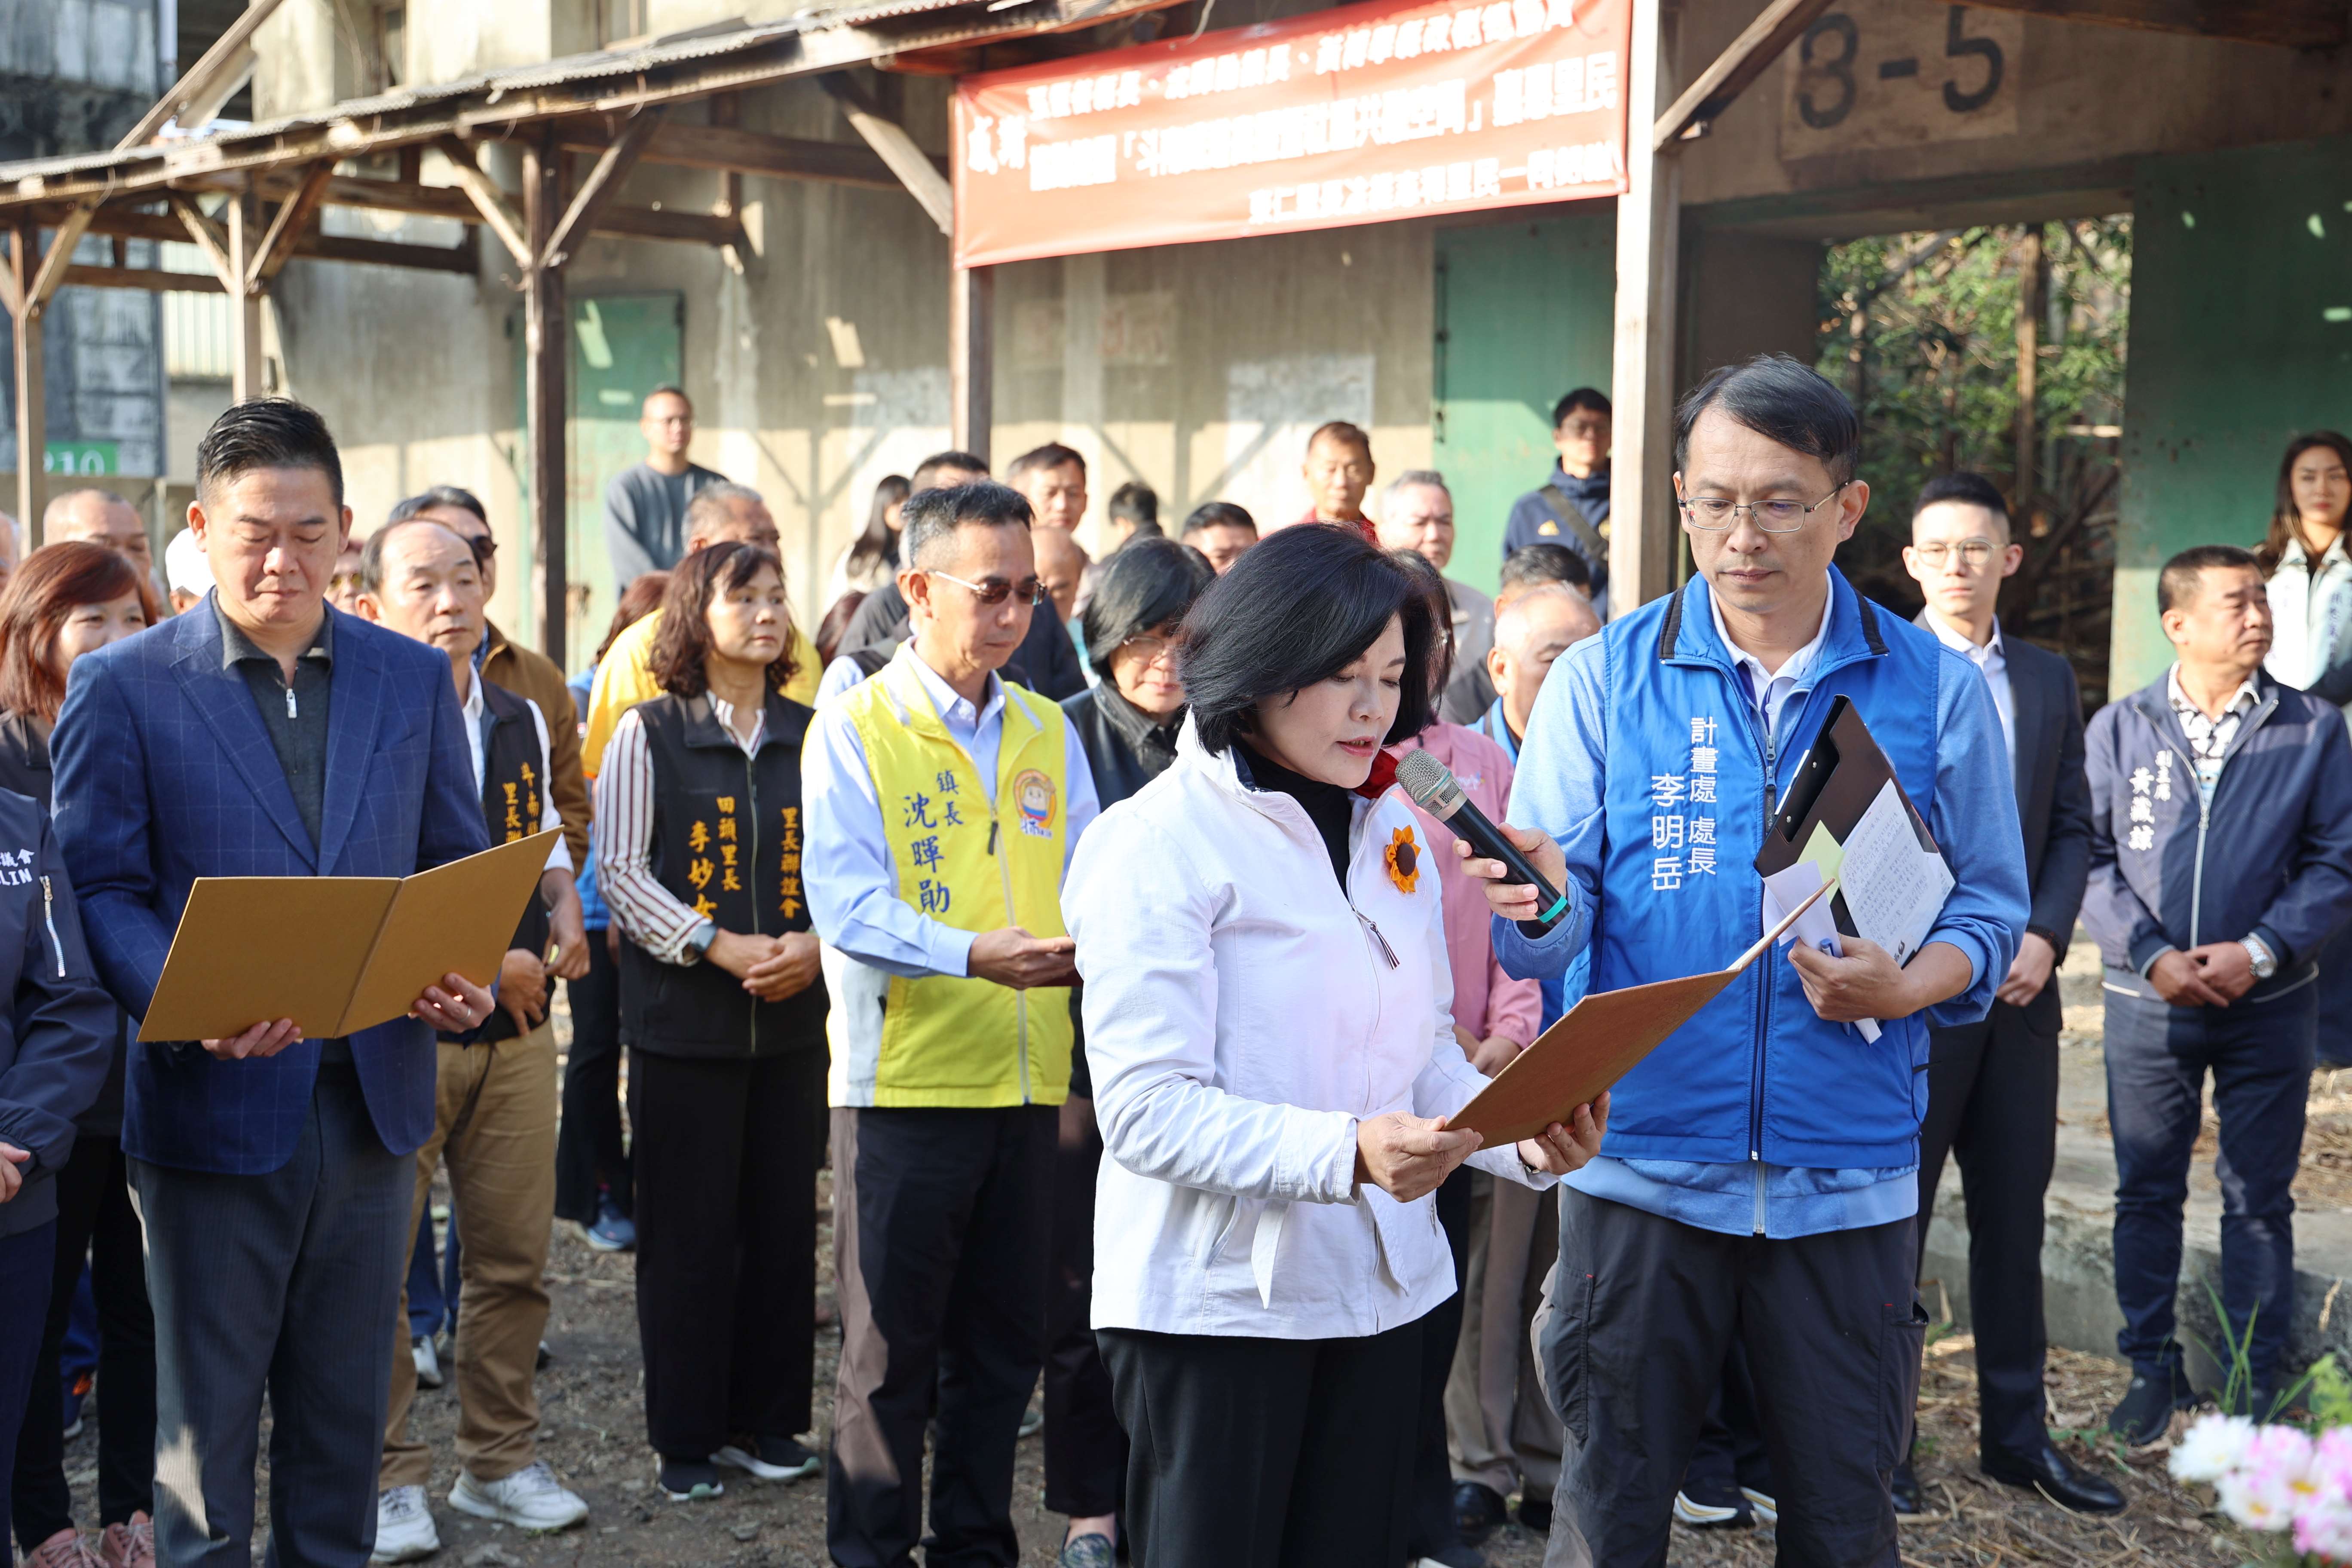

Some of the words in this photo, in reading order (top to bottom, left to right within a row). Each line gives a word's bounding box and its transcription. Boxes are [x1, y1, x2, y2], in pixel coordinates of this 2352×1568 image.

[1690, 717, 1718, 803] 計畫處
[937, 769, 964, 827] 鎮長
[1651, 773, 1684, 891] 李明岳
[0, 848, 35, 867] 議會
[0, 868, 33, 886] LIN
[716, 796, 742, 892] 田頭里長
[903, 792, 950, 913] 沈暉勛
[1688, 817, 1717, 875] 處長
